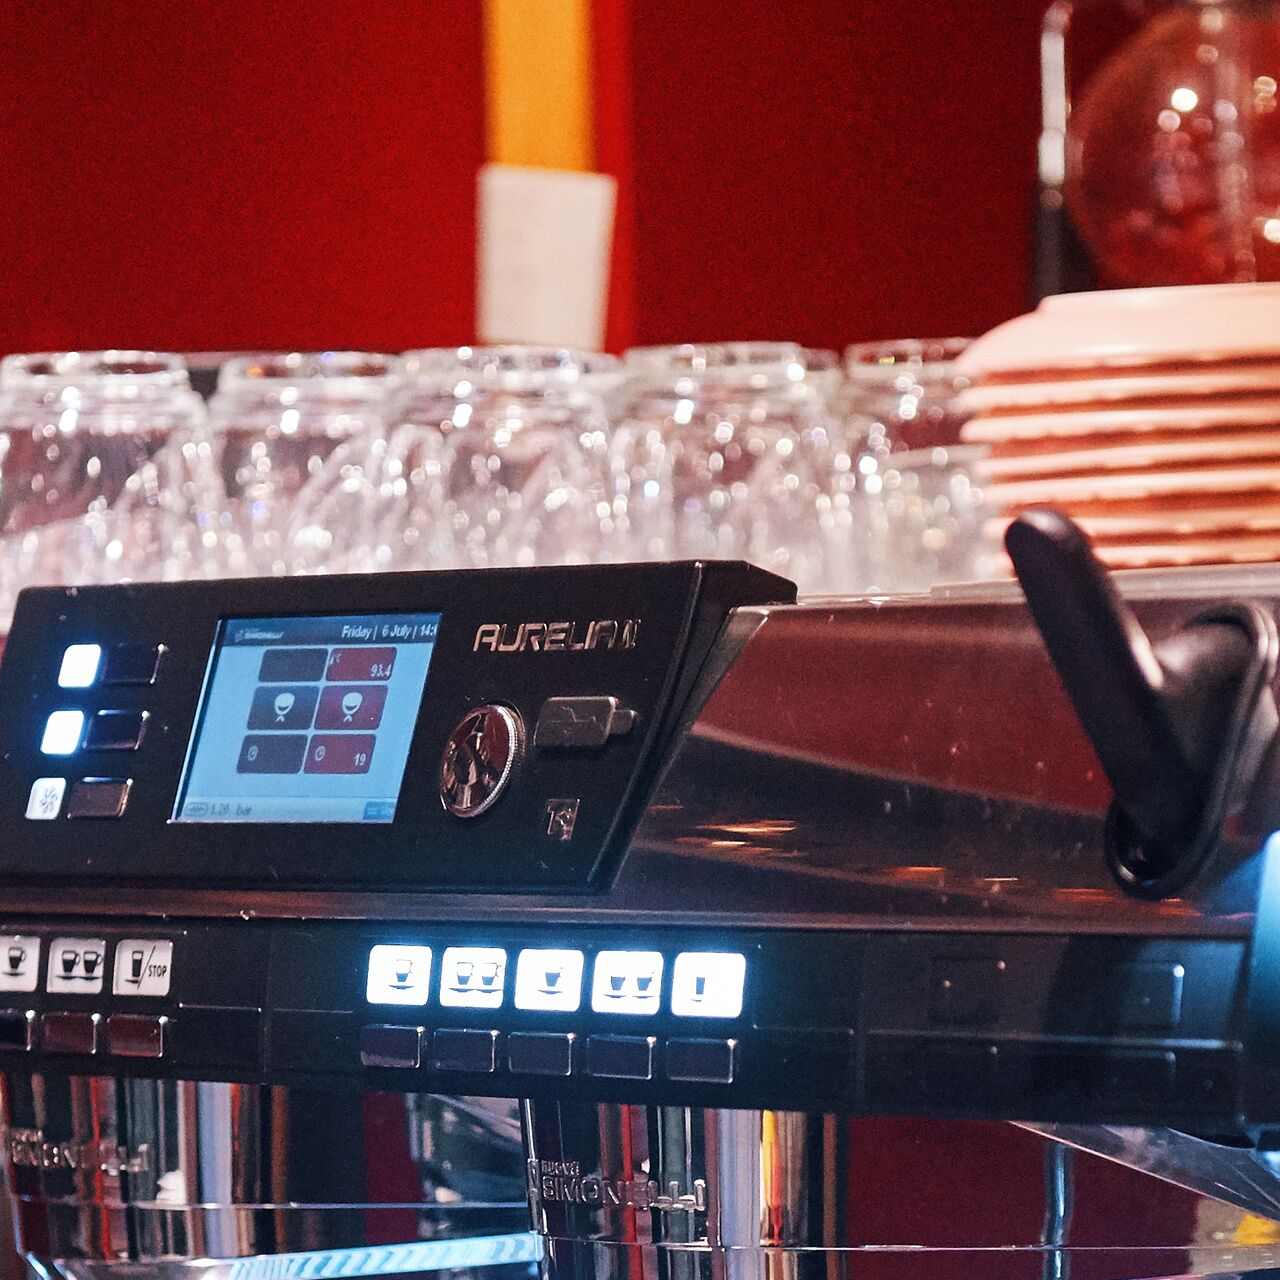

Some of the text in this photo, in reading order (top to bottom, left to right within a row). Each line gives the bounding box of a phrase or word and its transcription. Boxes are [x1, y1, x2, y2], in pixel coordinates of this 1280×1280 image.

[341, 624, 373, 640] Friday
[381, 625, 389, 638] 6
[390, 624, 412, 640] July
[472, 619, 618, 652] AURELIA
[370, 663, 392, 677] 93.4
[354, 752, 367, 767] 19
[148, 964, 167, 978] STOP
